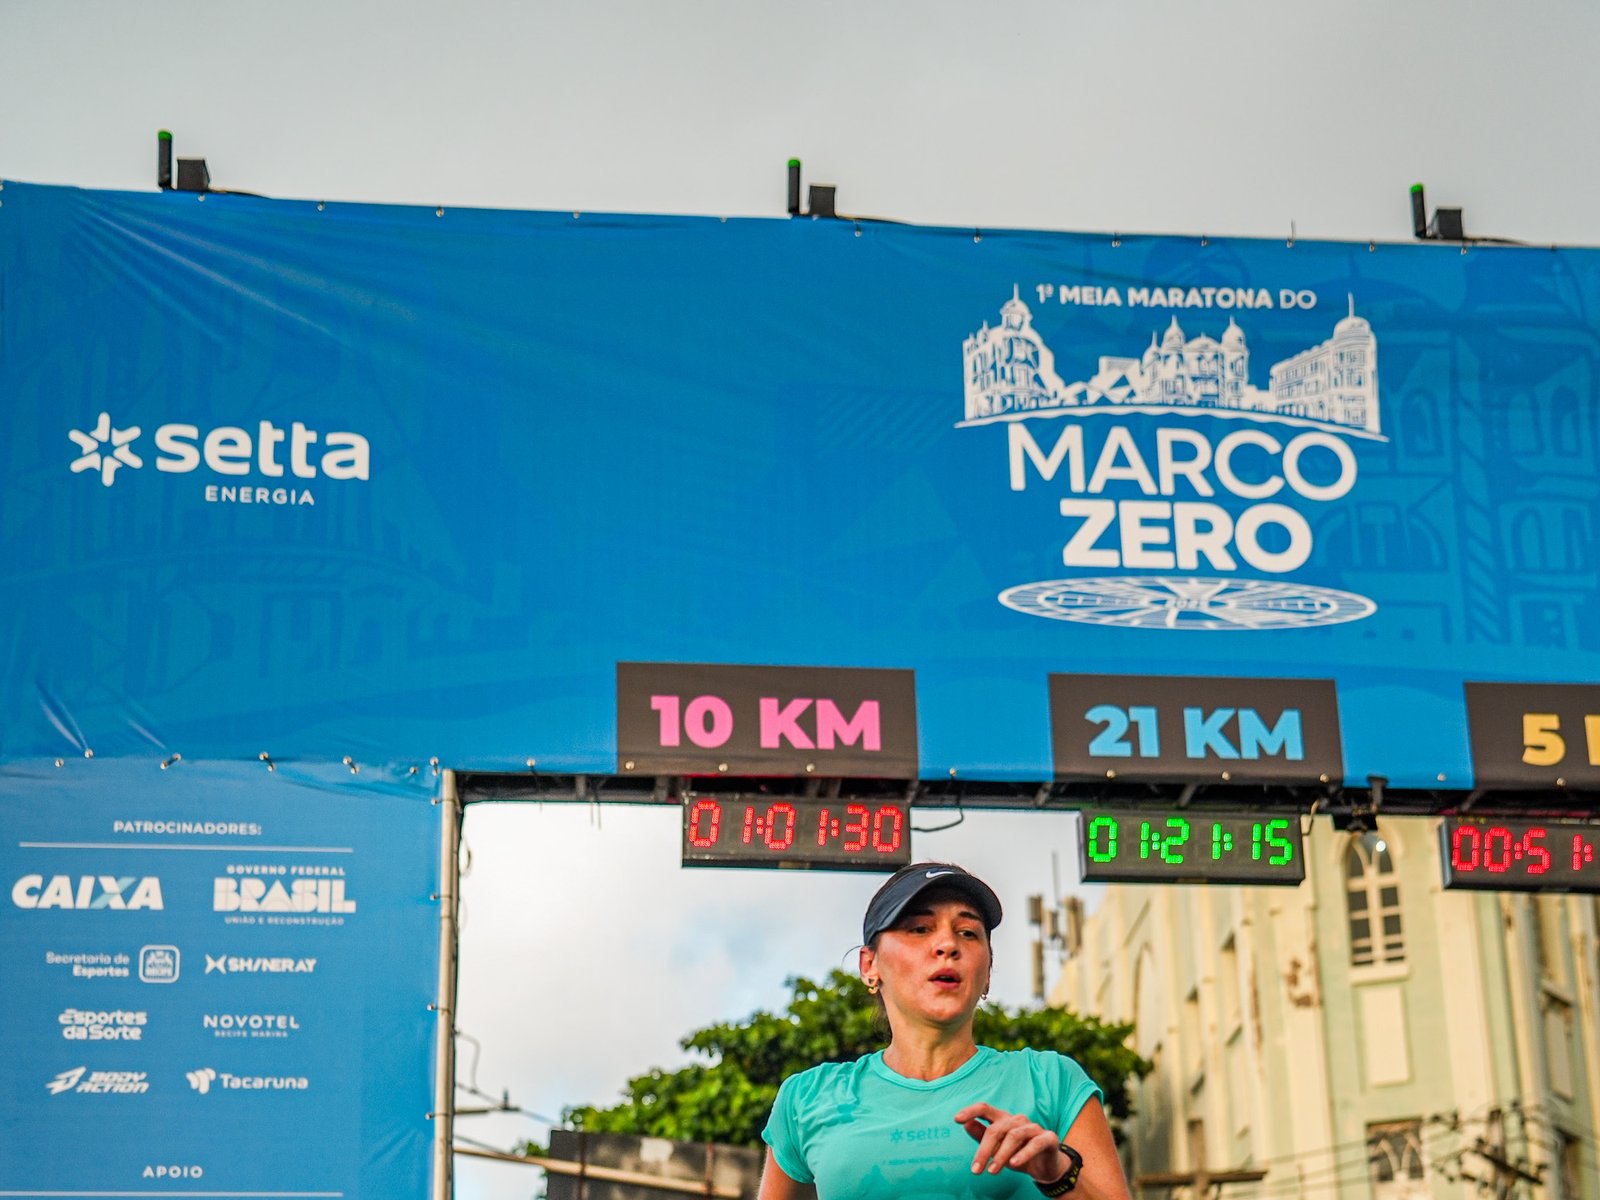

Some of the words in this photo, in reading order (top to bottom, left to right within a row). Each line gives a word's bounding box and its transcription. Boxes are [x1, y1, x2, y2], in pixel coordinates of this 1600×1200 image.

[1059, 285, 1122, 307] MEIA
[1127, 287, 1274, 309] MARATONA
[1279, 289, 1317, 310] DO
[155, 420, 370, 481] setta
[1007, 423, 1357, 501] MARCO
[205, 485, 314, 505] ENERGIA
[1060, 498, 1313, 573] ZERO
[651, 695, 733, 748] 10
[759, 697, 882, 751] KM
[1084, 705, 1160, 758] 21
[1183, 706, 1304, 761] KM
[1522, 713, 1566, 766] 5
[113, 820, 262, 836] PATROCINADORES:
[226, 864, 287, 875] GOVERNO
[290, 865, 346, 876] FEDERAL
[11, 874, 165, 911] CAIXA
[213, 876, 357, 914] BRASIL
[113, 953, 130, 965] de
[73, 964, 130, 979] Esportes
[203, 1014, 300, 1030] NOVOTEL
[220, 1073, 309, 1089] Tacaruna
[906, 1128, 951, 1142] setta
[142, 1165, 203, 1179] APOIO
